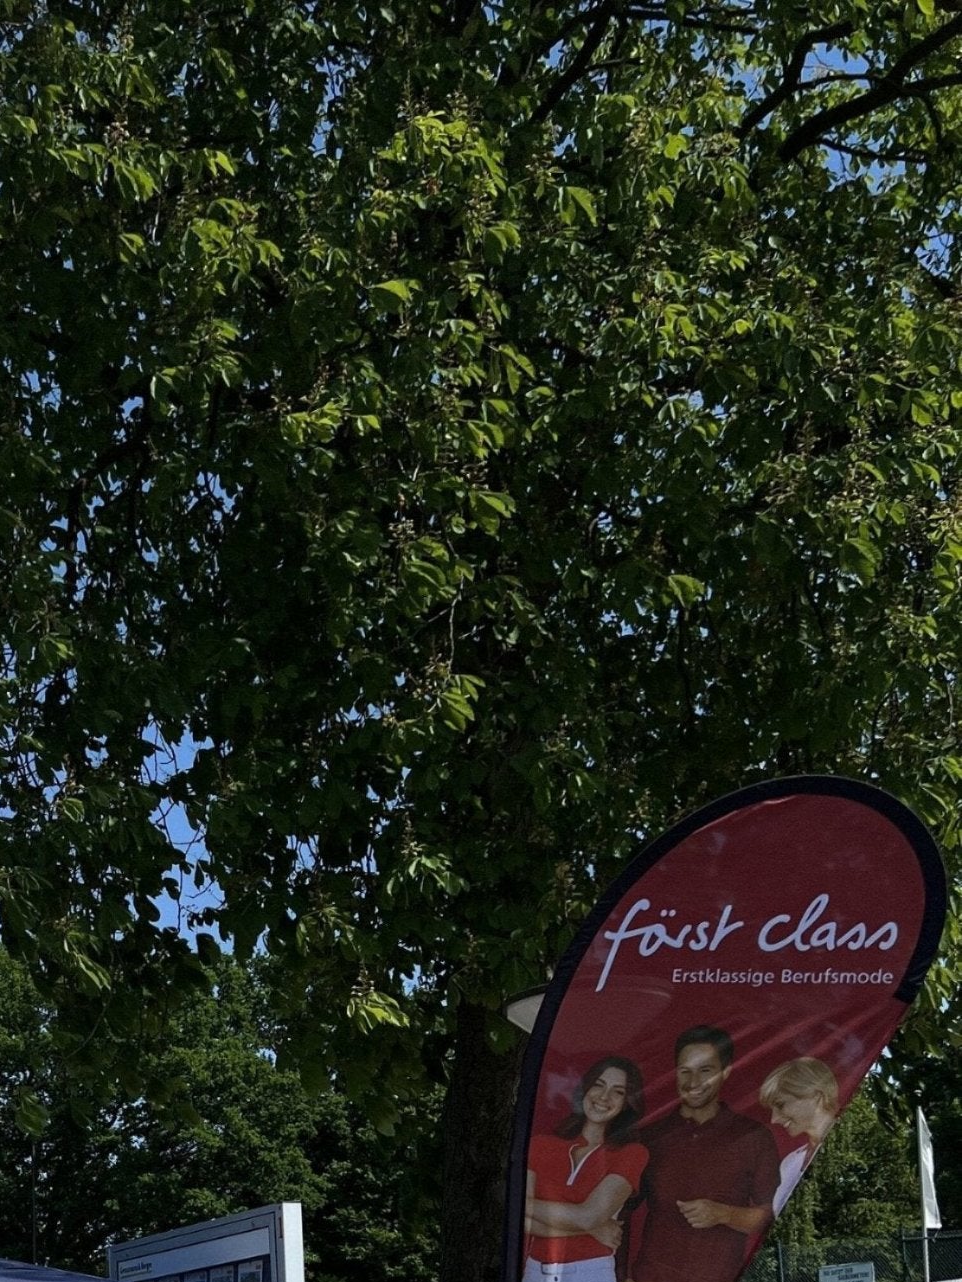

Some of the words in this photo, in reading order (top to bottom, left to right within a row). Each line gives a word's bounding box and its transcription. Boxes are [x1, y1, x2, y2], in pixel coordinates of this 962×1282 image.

[758, 893, 898, 951] class
[672, 968, 775, 987] Erstklassige
[781, 968, 894, 984] Berufsmode
